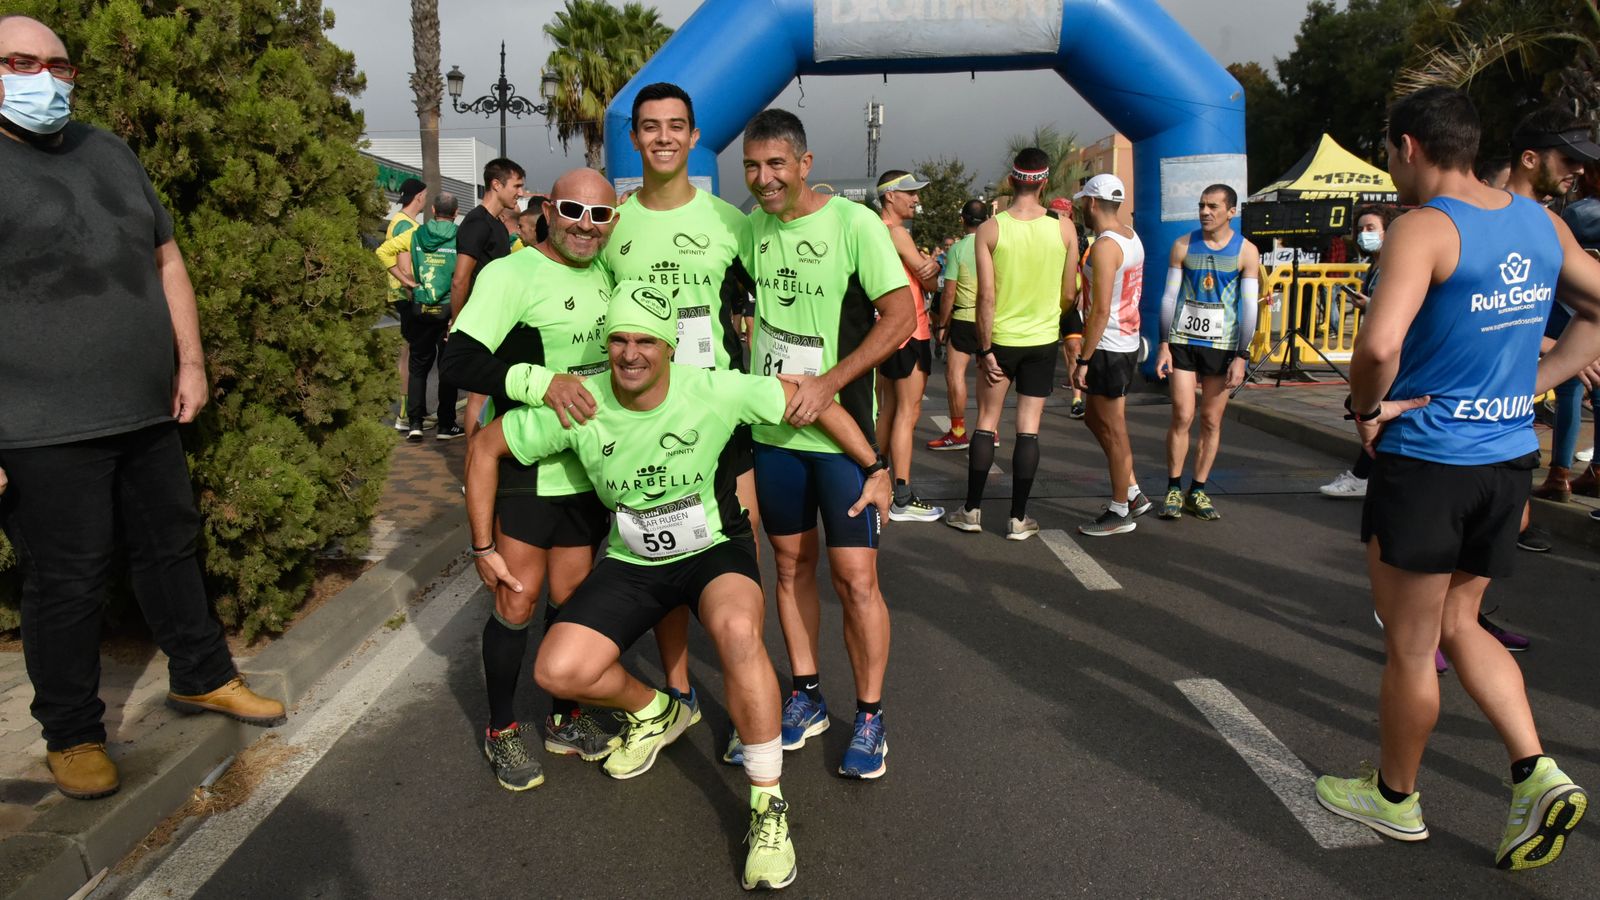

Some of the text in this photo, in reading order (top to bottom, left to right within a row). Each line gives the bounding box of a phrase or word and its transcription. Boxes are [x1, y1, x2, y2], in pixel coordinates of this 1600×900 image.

[799, 257, 822, 265] INFINITY
[1470, 283, 1552, 312] Ruiz Galán
[1185, 315, 1210, 333] 308
[763, 353, 783, 376] 81
[1454, 394, 1535, 421] ESQUIV
[666, 448, 695, 458] INFINITY
[606, 472, 703, 491] MARBELLA
[642, 530, 676, 552] 59
